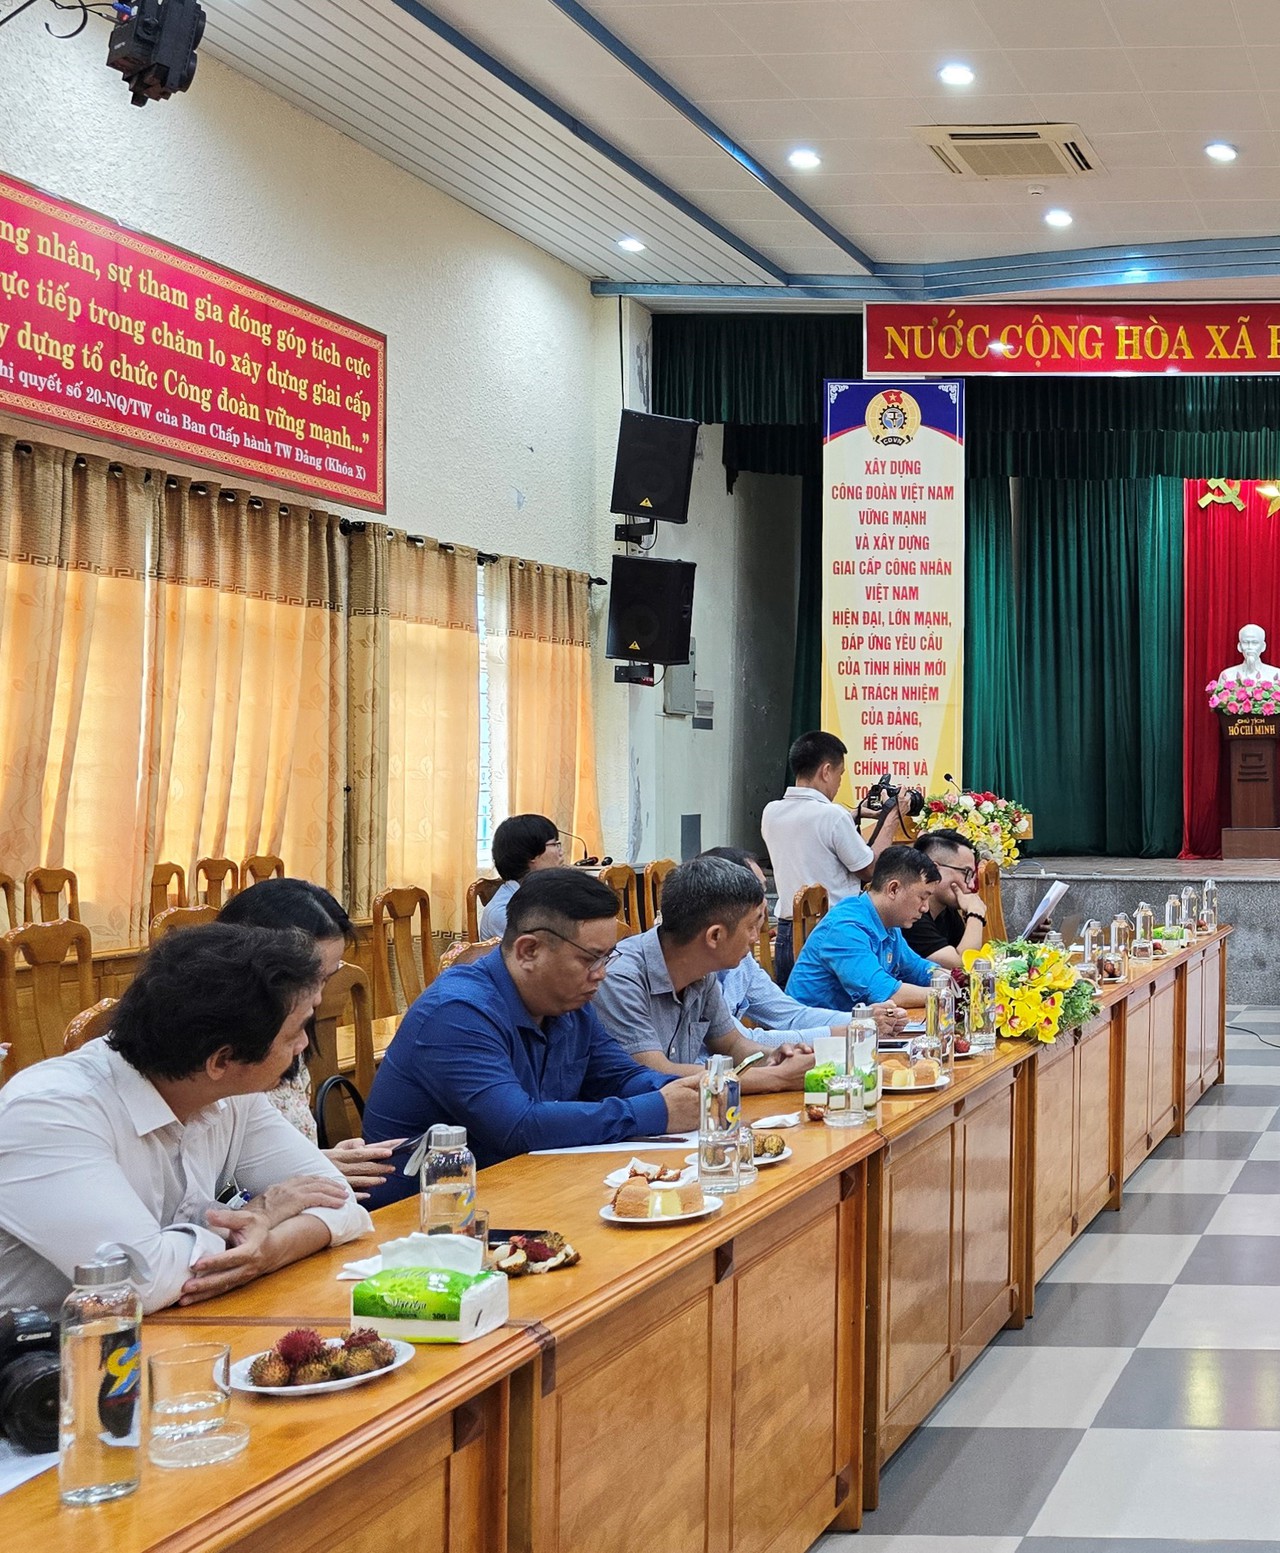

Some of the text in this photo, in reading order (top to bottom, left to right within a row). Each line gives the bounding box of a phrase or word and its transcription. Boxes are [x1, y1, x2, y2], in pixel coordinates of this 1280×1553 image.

[37, 231, 100, 281] nhân,
[107, 263, 133, 293] sự
[139, 268, 189, 310] tham
[195, 294, 223, 322] gia
[228, 304, 272, 346] đóng
[277, 326, 306, 359] góp
[311, 337, 341, 367] tích
[345, 356, 370, 380] cực
[884, 309, 990, 360] NƯỚC
[1002, 315, 1104, 368] CỘNG
[1114, 315, 1195, 360] HÒA
[1205, 316, 1255, 360] XÃ
[37, 278, 82, 323] tiếp
[88, 297, 146, 345] trong
[151, 321, 204, 360] chăm
[208, 338, 226, 367] lo
[231, 352, 262, 385] xây
[267, 361, 308, 401] dựng
[312, 379, 341, 407] giai
[345, 390, 371, 422] cấp
[19, 370, 367, 481] quyết số 20-NQ/TW của Ban Chấp hành TW Đảng (Khóa X)
[865, 458, 921, 477] XÂY DỰNG
[832, 483, 954, 503] CÔNG ĐOÀN VIỆT NAM
[859, 508, 926, 528] VỮNG MẠNH
[842, 631, 942, 650] ĐÁP ỨNG YÊU CẦU
[838, 656, 946, 675] CỦA TÌNH HÌNH MỚI
[845, 683, 938, 704] LÀ TRÁCH NHIỆM
[1254, 725, 1276, 735] MINH
[864, 731, 919, 754] HỆ THỐNG
[854, 758, 928, 779] CHÍNH TRỊ VÀ
